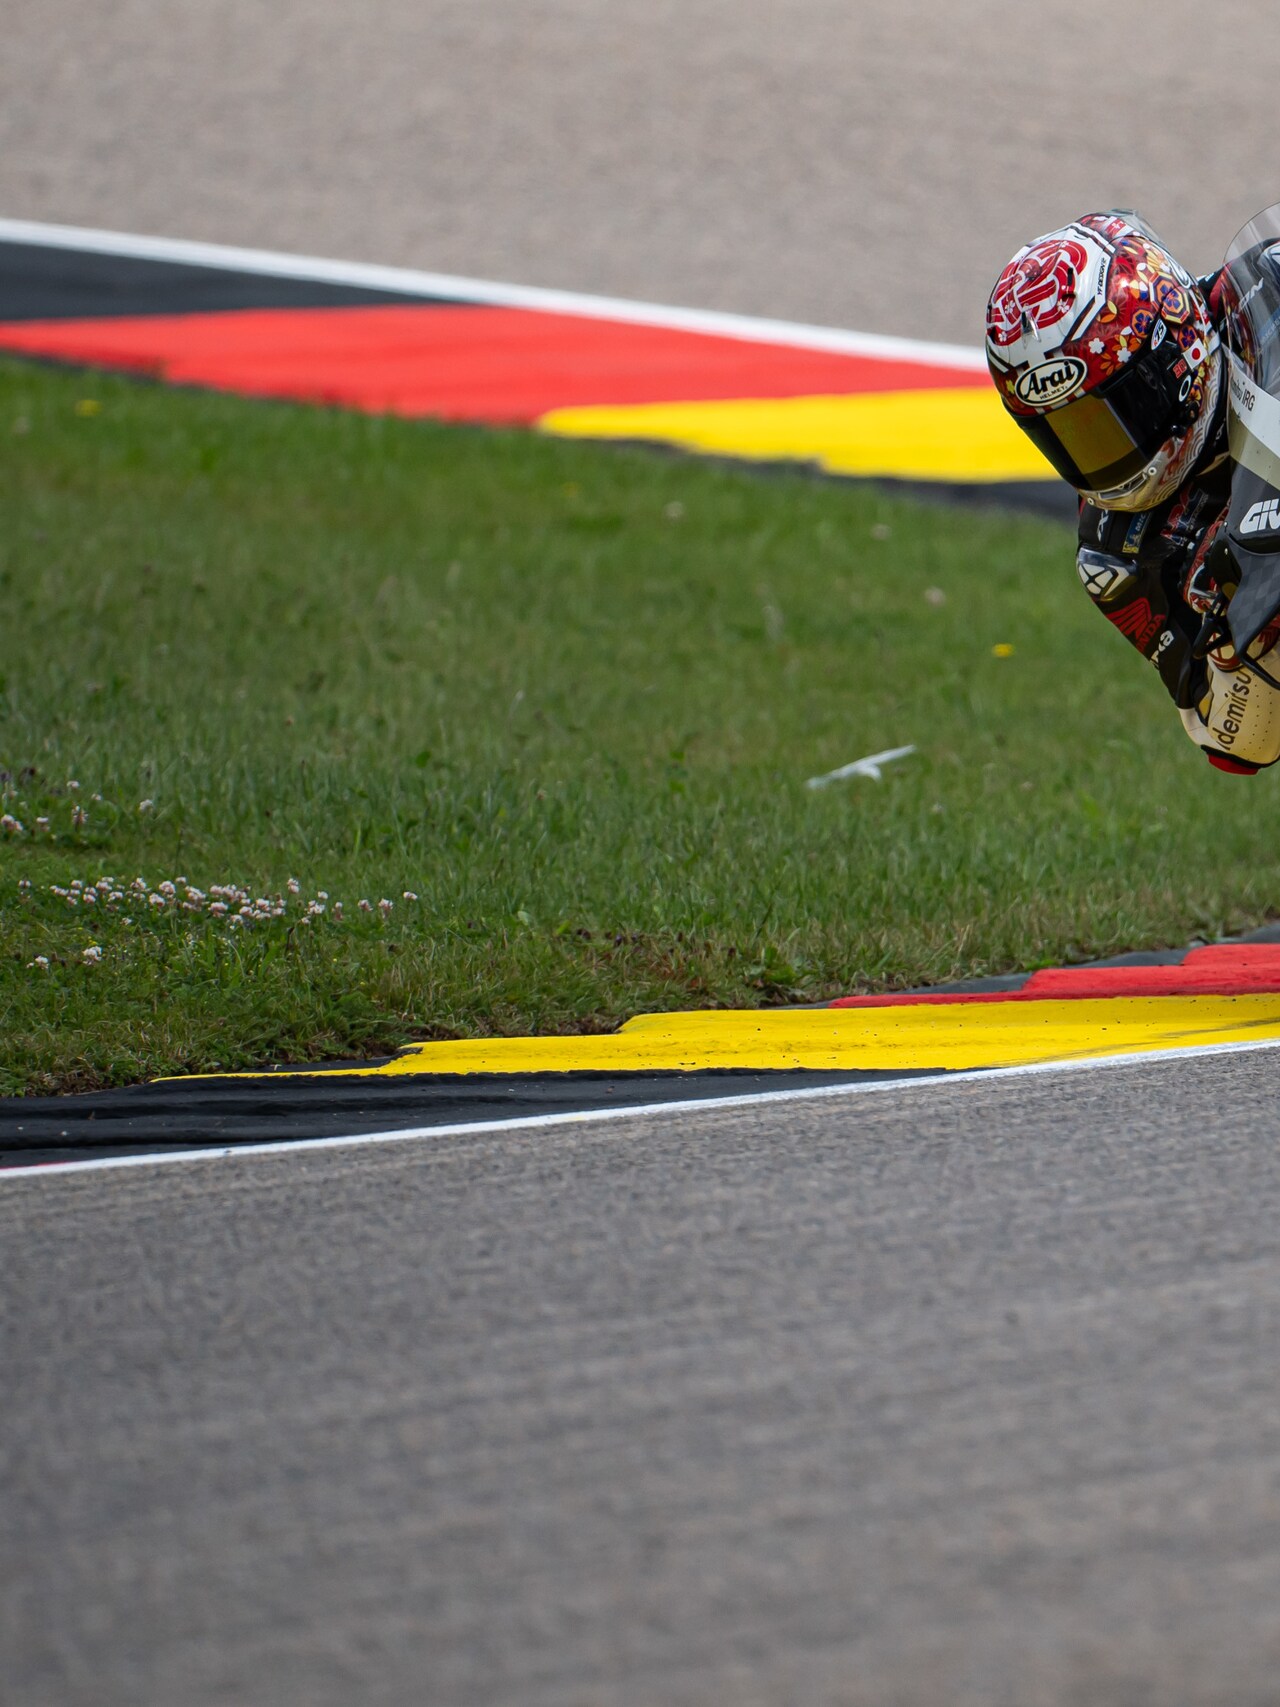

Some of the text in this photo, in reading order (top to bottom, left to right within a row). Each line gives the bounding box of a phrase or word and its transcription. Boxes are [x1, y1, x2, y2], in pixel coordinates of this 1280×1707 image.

[1023, 360, 1075, 399] Arai
[1173, 358, 1188, 379] 30
[1243, 390, 1256, 412] IRG
[1213, 670, 1252, 751] idemitsu
